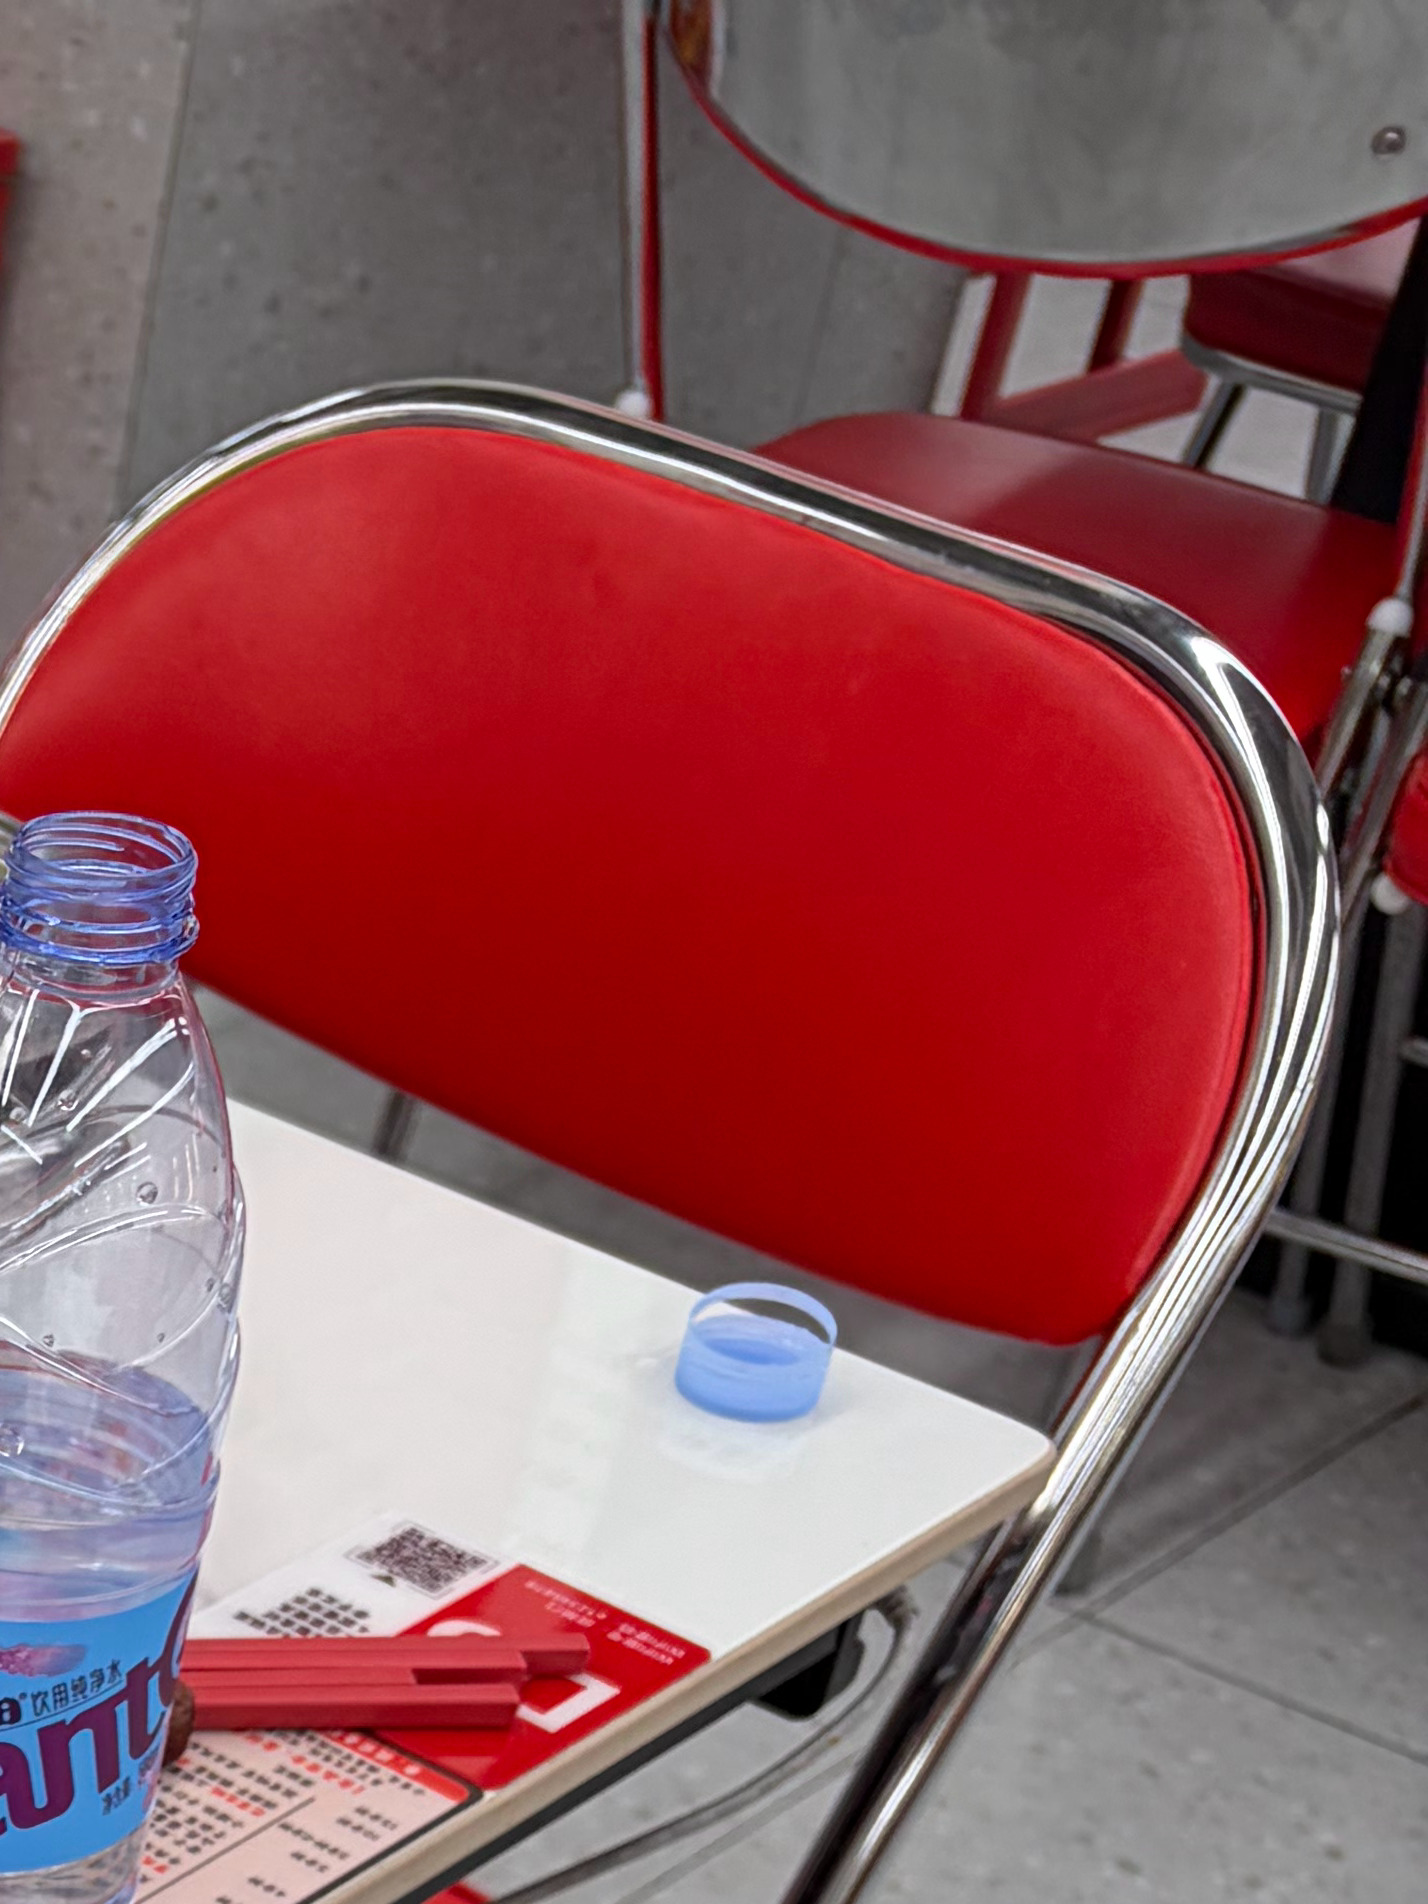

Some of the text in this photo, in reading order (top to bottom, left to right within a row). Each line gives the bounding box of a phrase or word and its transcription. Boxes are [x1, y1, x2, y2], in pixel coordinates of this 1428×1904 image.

[30, 1658, 123, 1717] 饮用纯净水
